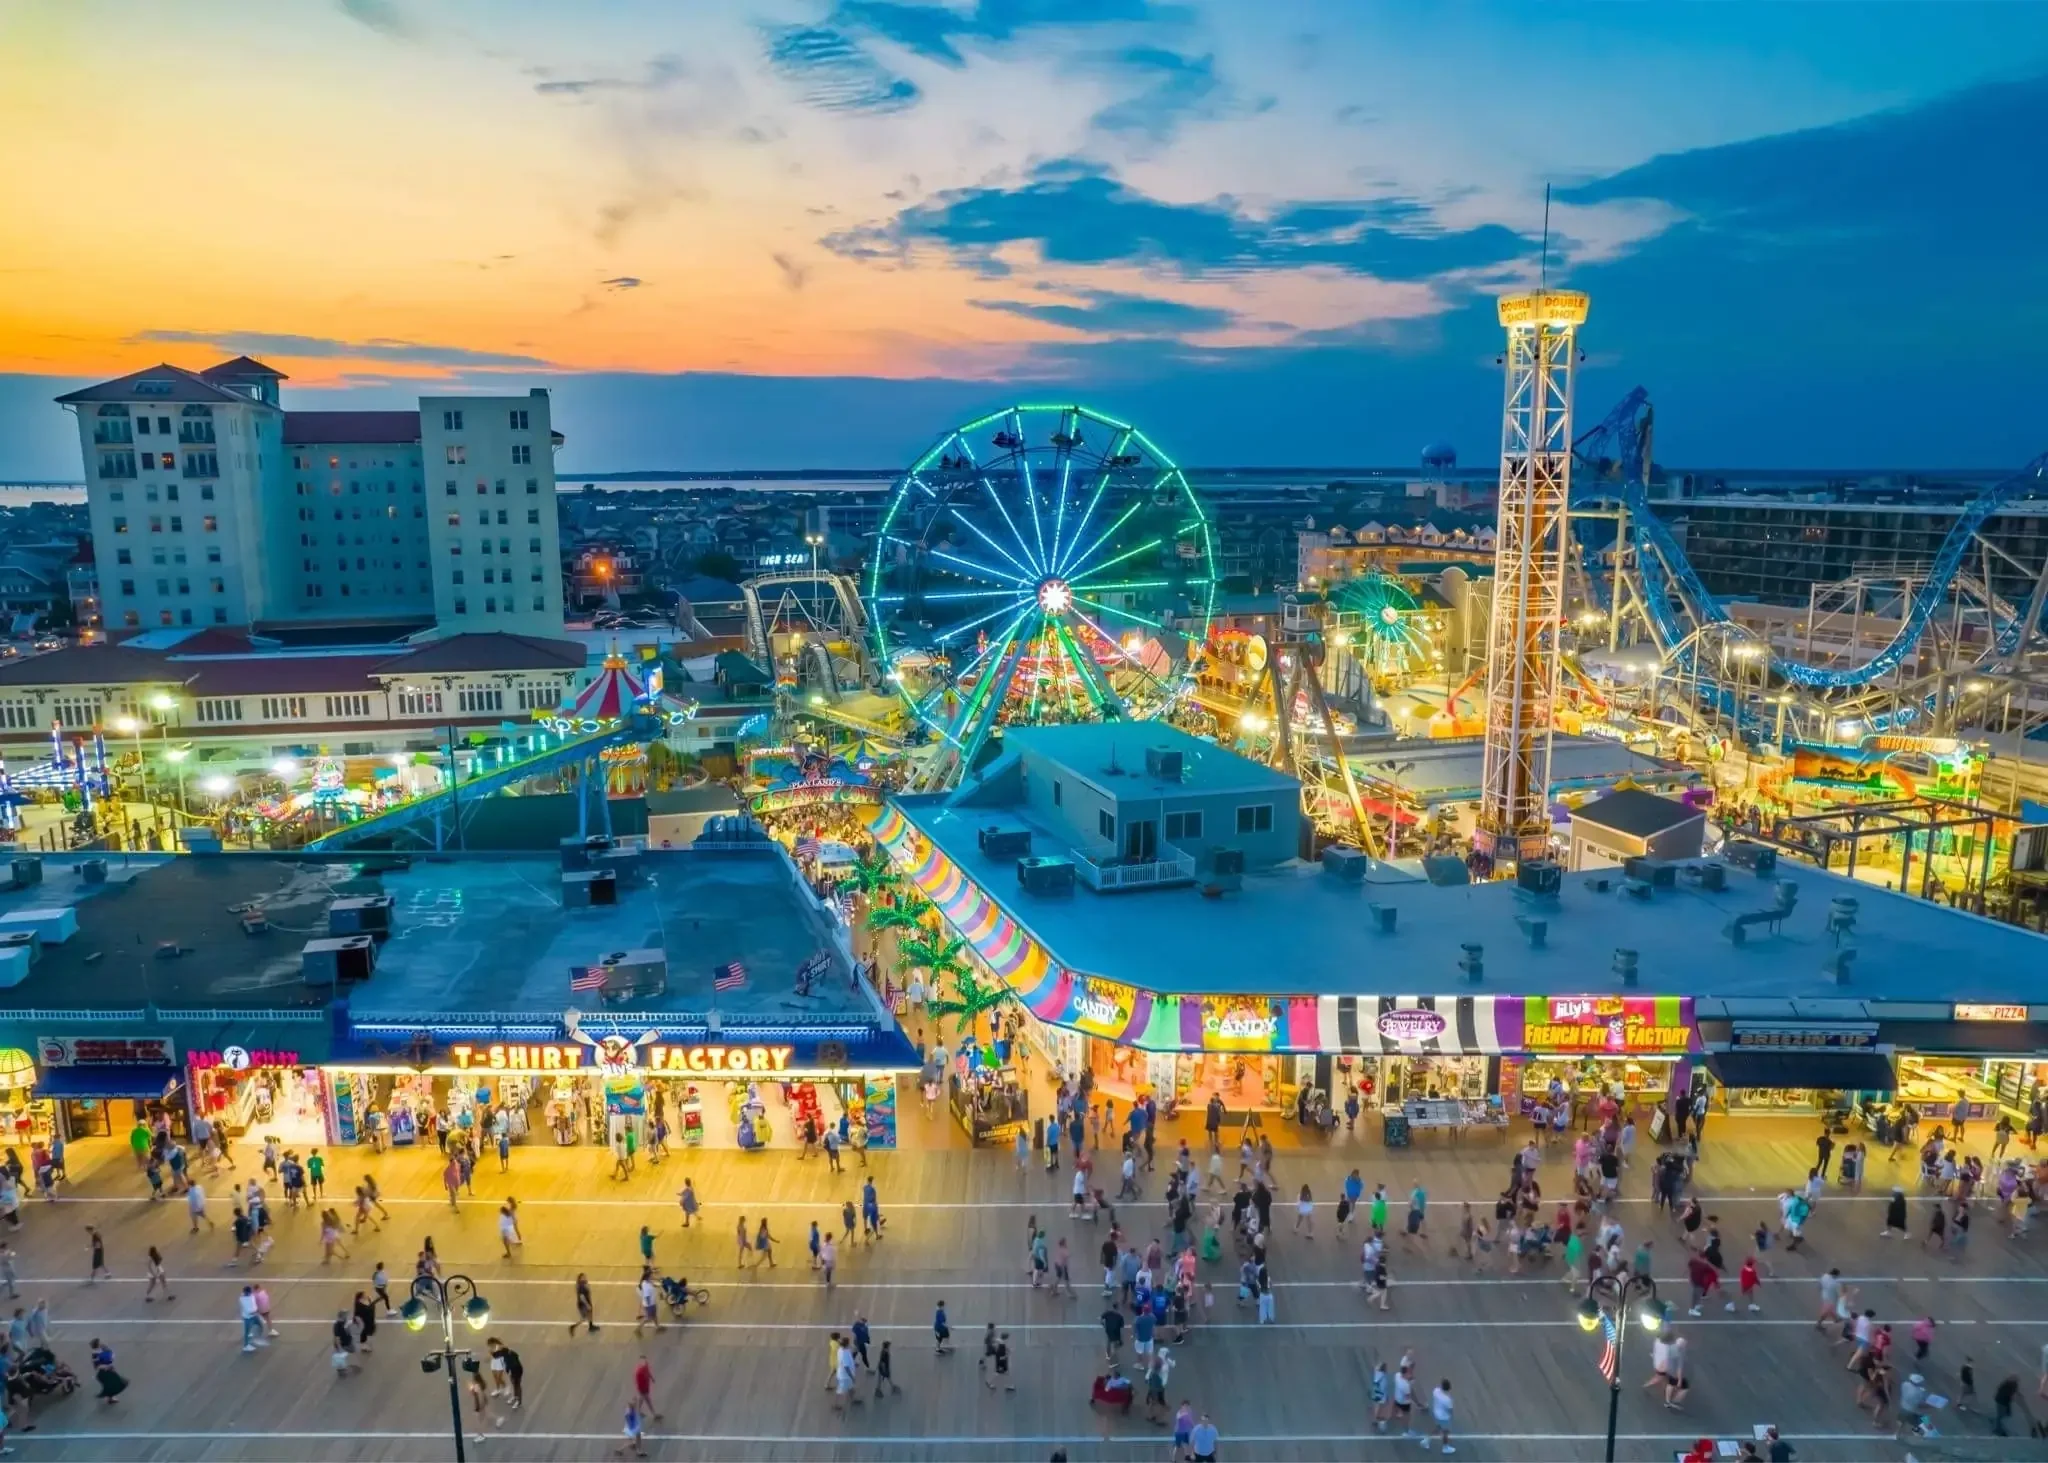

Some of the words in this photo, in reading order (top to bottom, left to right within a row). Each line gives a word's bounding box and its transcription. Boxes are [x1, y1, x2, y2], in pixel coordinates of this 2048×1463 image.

[1501, 299, 1531, 312] DOUBLE
[1545, 297, 1585, 308] DOUBLE
[1550, 309, 1577, 319] SHOT
[1073, 996, 1119, 1025] CANDY
[1995, 1007, 2025, 1019] PIZZA
[1205, 1016, 1279, 1034] CANDY
[1380, 1018, 1441, 1033] JEWELRY
[1525, 1023, 1580, 1046] FRENCH
[1582, 1024, 1609, 1046] FRY
[1627, 1026, 1692, 1046] FACTORY
[1839, 1035, 1869, 1046] UP
[453, 1045, 582, 1070] T-SHIRT
[650, 1046, 792, 1071] FACTORY
